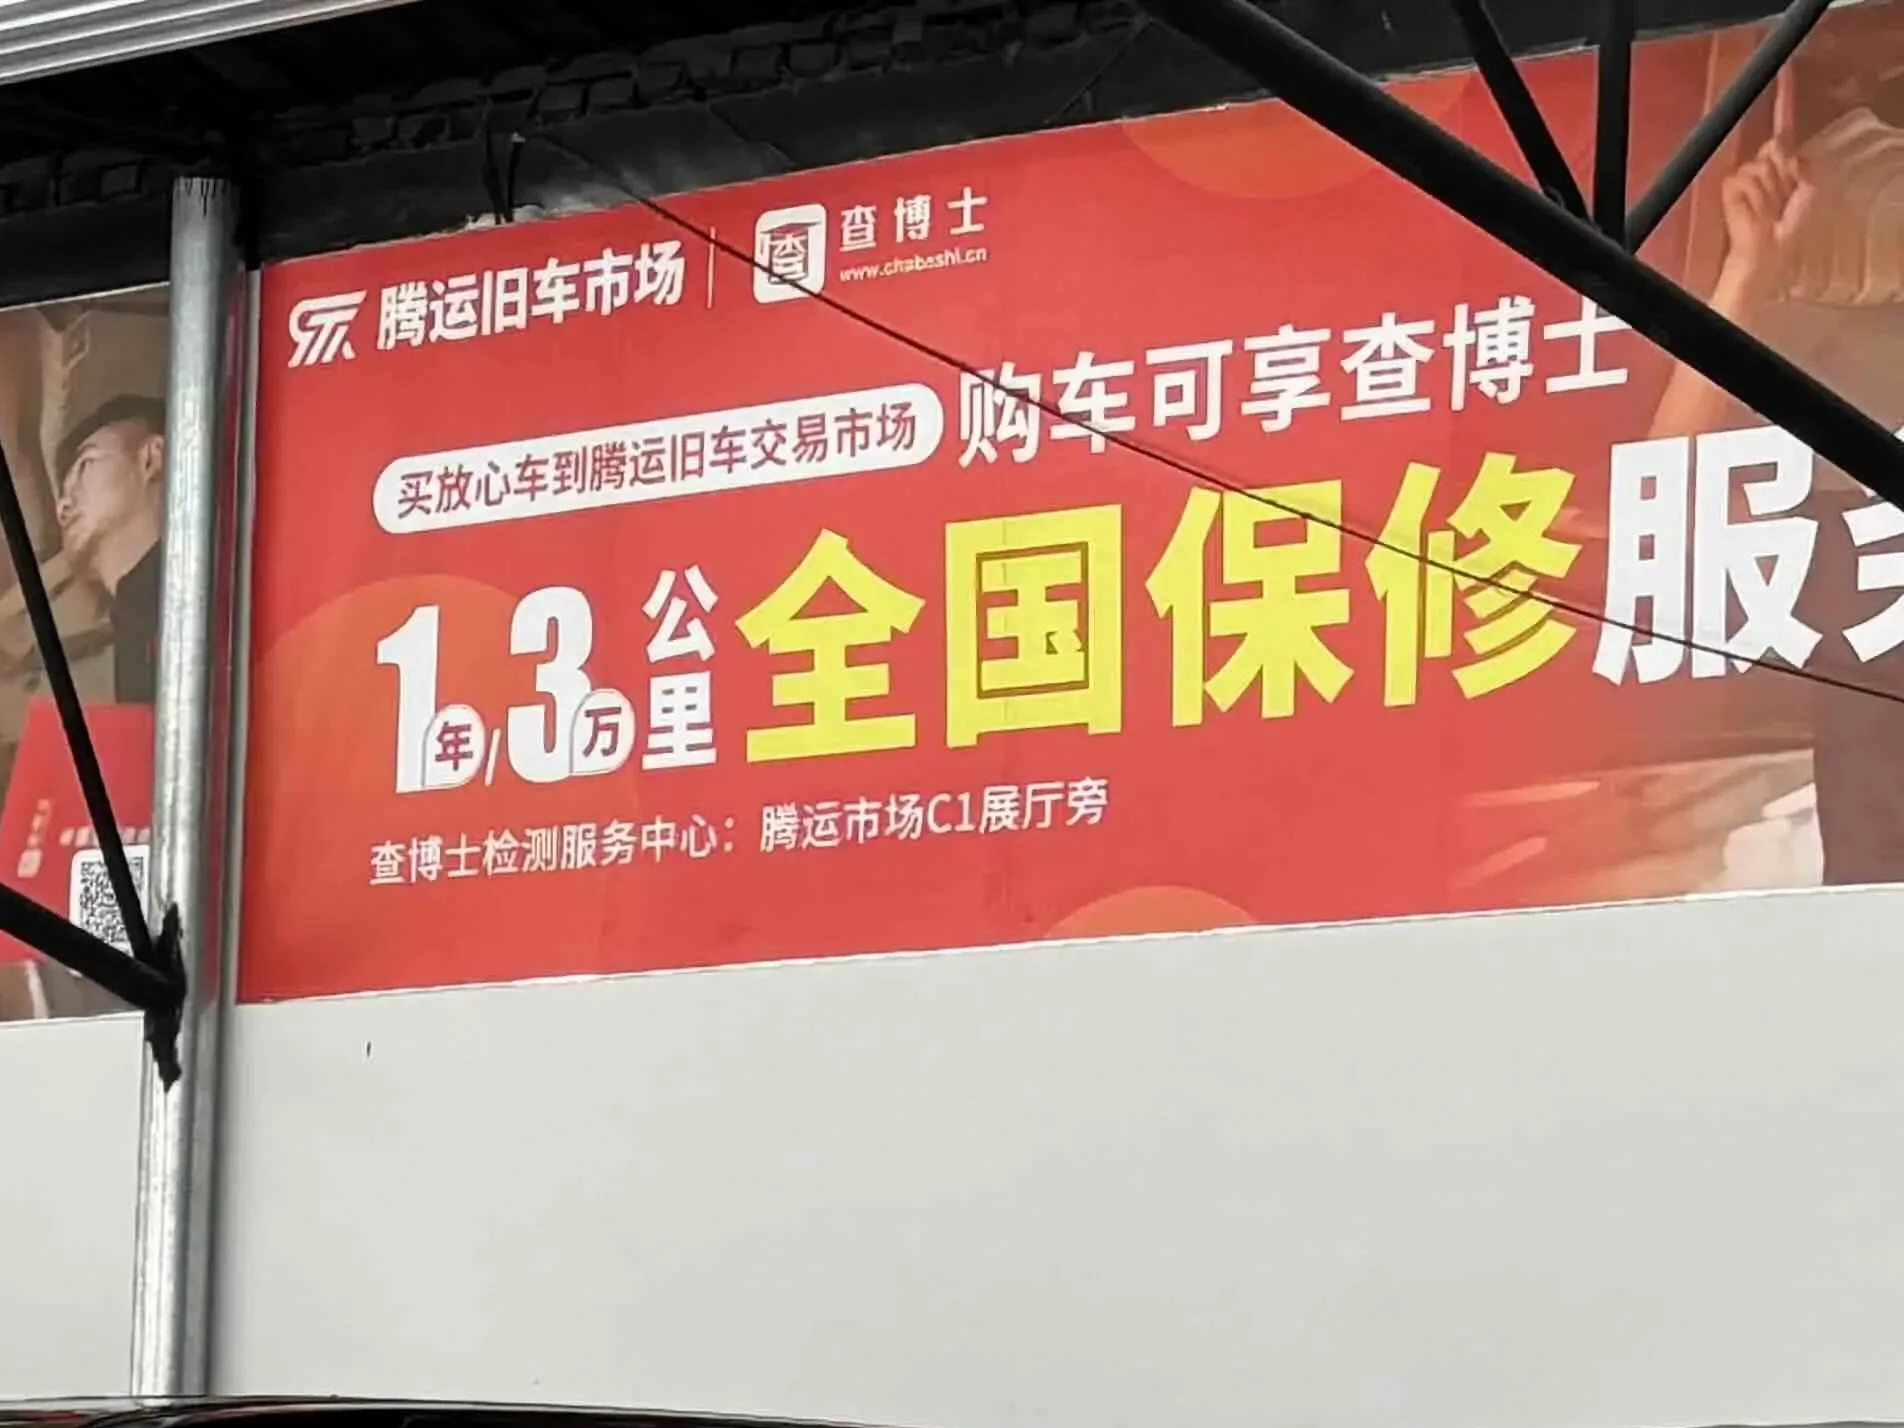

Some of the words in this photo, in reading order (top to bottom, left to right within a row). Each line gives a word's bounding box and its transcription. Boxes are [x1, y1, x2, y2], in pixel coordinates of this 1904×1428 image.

[840, 187, 988, 251] 查博士
[377, 238, 685, 350] 腾运旧车市场
[957, 295, 1632, 469] 购车可享查博士
[396, 402, 917, 518] 买放心车到腾运旧车交易市场
